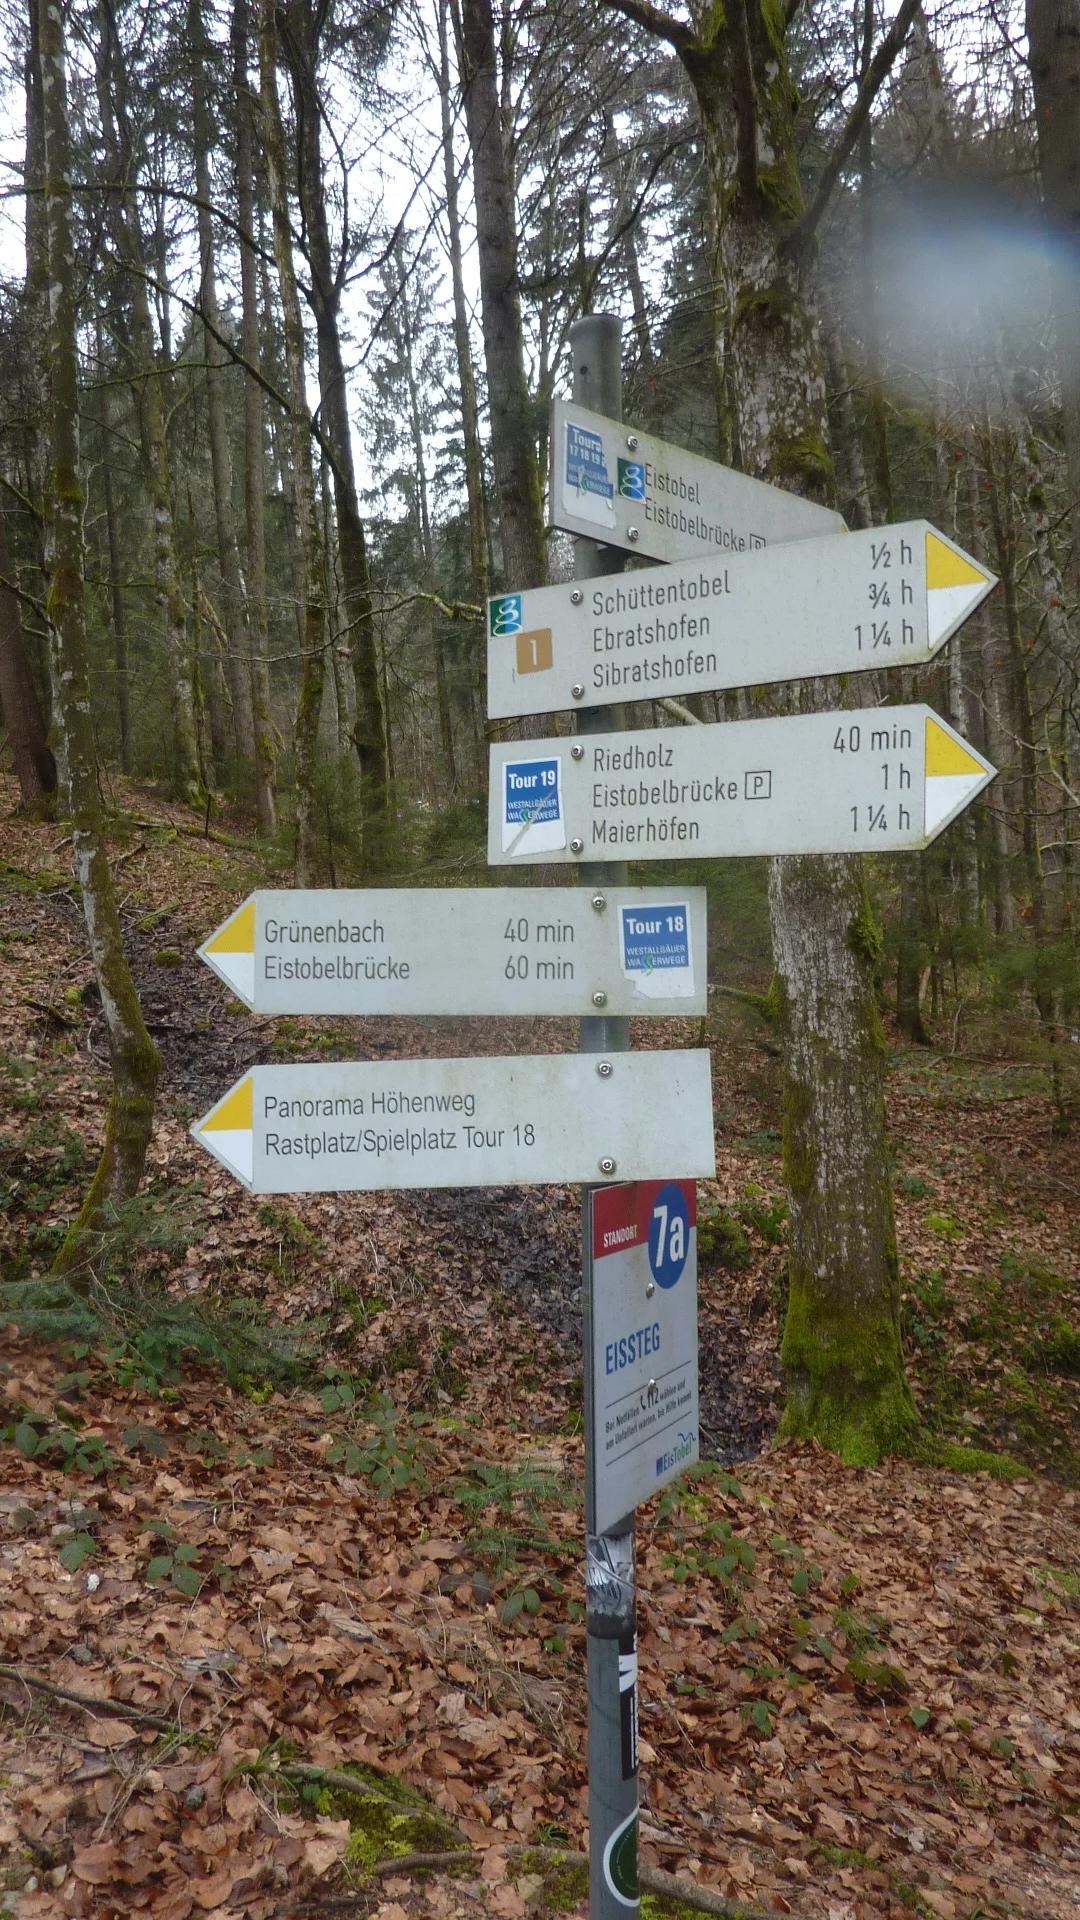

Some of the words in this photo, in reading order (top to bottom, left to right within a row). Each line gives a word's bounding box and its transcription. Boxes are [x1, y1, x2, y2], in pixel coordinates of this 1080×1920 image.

[645, 463, 701, 505] Eistobel
[645, 497, 746, 553] Eistobelbrücke
[900, 539, 912, 565] h
[592, 569, 731, 616] Schüttentobel
[901, 579, 913, 605] h
[593, 613, 710, 652] Ebratshofen
[902, 618, 914, 645] h
[530, 638, 538, 666] 1
[593, 650, 717, 688] Sibratshofen
[833, 726, 861, 754] 40
[871, 723, 912, 751] min
[593, 743, 674, 772] Riedholz
[508, 772, 538, 790] Tour
[541, 770, 556, 787] 19
[881, 763, 889, 790] 1
[899, 763, 911, 789] h
[593, 776, 738, 808] Eistobelbrücke
[753, 776, 764, 796] P
[899, 803, 910, 830] h
[592, 817, 700, 844] Maierhöfen
[264, 919, 385, 943] Grünenbach
[504, 918, 529, 943] 40
[536, 919, 574, 943] min
[625, 917, 663, 935] Tour
[666, 915, 684, 933] 18
[626, 944, 686, 956] WESTALLGÄUER
[264, 955, 411, 980] Eistobelbrücke
[504, 955, 529, 980] 60
[536, 956, 574, 980] min
[264, 1095, 364, 1119] Panorama
[371, 1091, 476, 1117] Höhenweg
[265, 1127, 457, 1160] Rastplatz/Spielplatz
[463, 1125, 505, 1150] Tour
[512, 1123, 536, 1147] 18
[603, 1224, 638, 1248] STANDORT
[653, 1204, 685, 1269] 7a
[605, 1321, 661, 1376] EISSTEG
[605, 1419, 615, 1434] Bei
[663, 1437, 692, 1473] EisTobel
